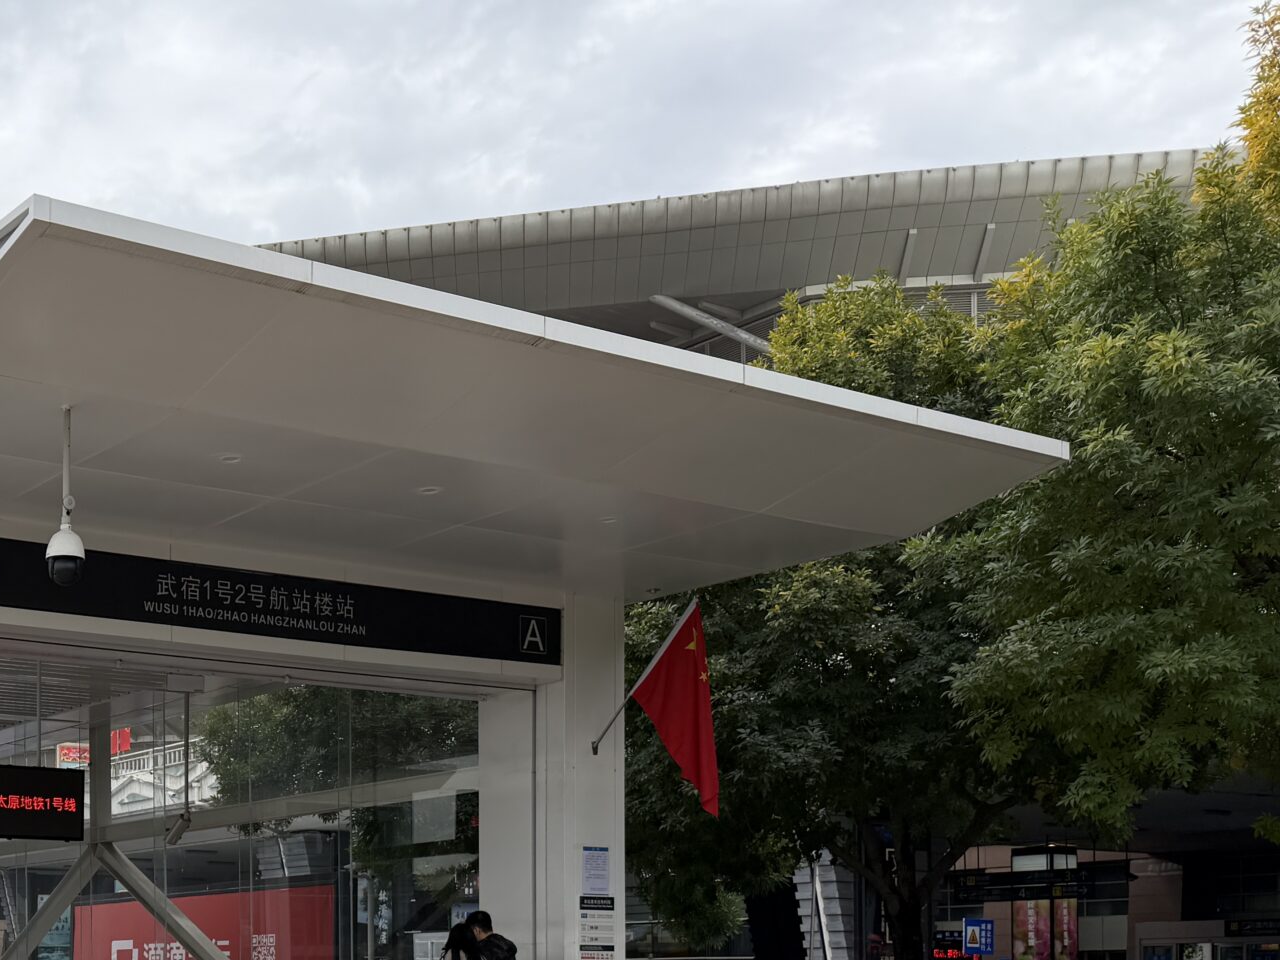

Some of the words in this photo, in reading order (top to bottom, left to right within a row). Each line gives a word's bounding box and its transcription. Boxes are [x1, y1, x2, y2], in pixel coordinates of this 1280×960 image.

[156, 572, 355, 619] 武宿1号2号航站楼站
[143, 600, 179, 615] WUSU
[182, 605, 248, 623] 1HAO/2HAO
[250, 613, 335, 632] HANGZHANLOU
[337, 622, 366, 636] ZHAN
[523, 619, 544, 652] A
